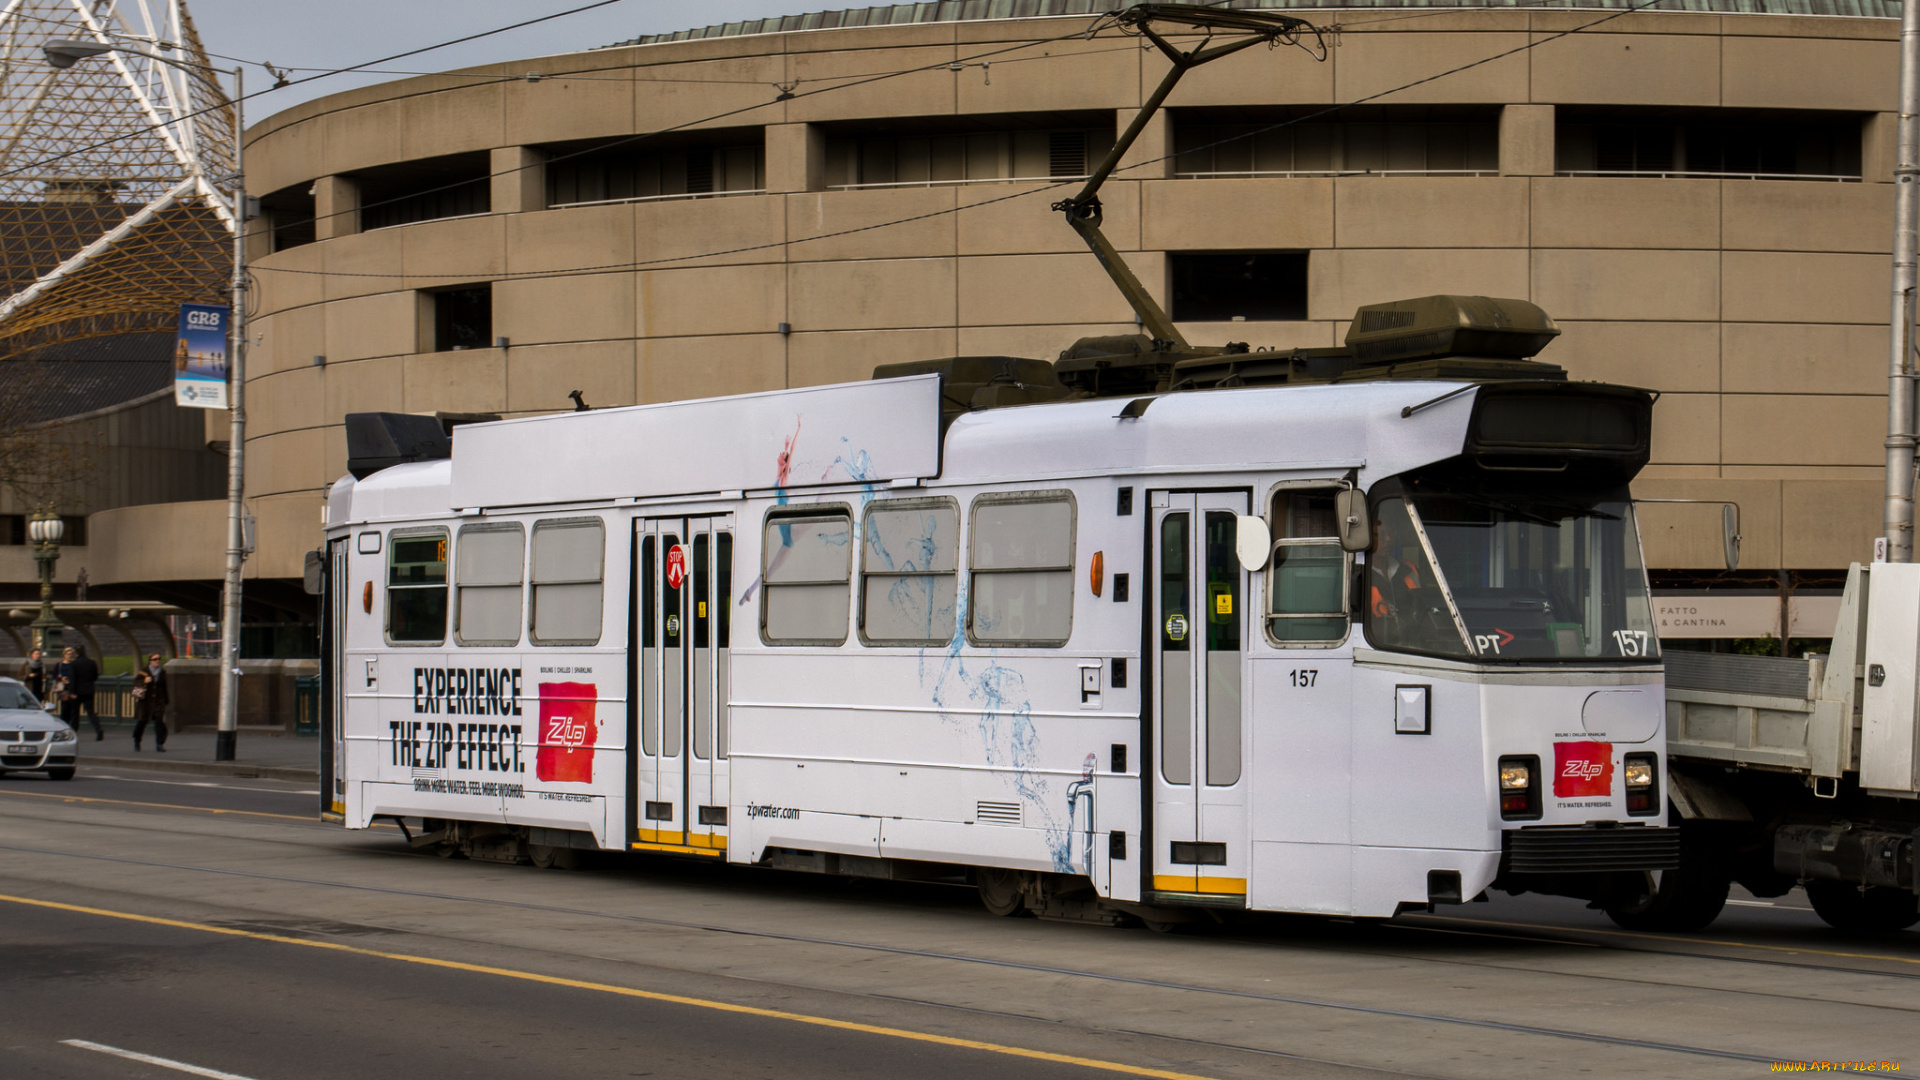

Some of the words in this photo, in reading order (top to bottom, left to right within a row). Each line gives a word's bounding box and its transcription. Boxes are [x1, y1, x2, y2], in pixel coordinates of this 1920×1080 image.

[187, 311, 220, 325] GR8
[669, 551, 682, 562] STOP
[1660, 607, 1697, 615] FATTO
[1612, 629, 1648, 657] 157
[1290, 669, 1318, 687] 157
[414, 667, 522, 716] EXPERIENCE
[546, 716, 586, 753] Zip
[389, 720, 421, 767] THE
[426, 722, 453, 768] ZIP
[457, 723, 525, 773] EFFECT.
[1562, 760, 1603, 781] Zip
[414, 778, 430, 792] DRINK
[431, 779, 447, 793] MORE
[469, 781, 481, 796] FEEL
[482, 782, 497, 797] MORE
